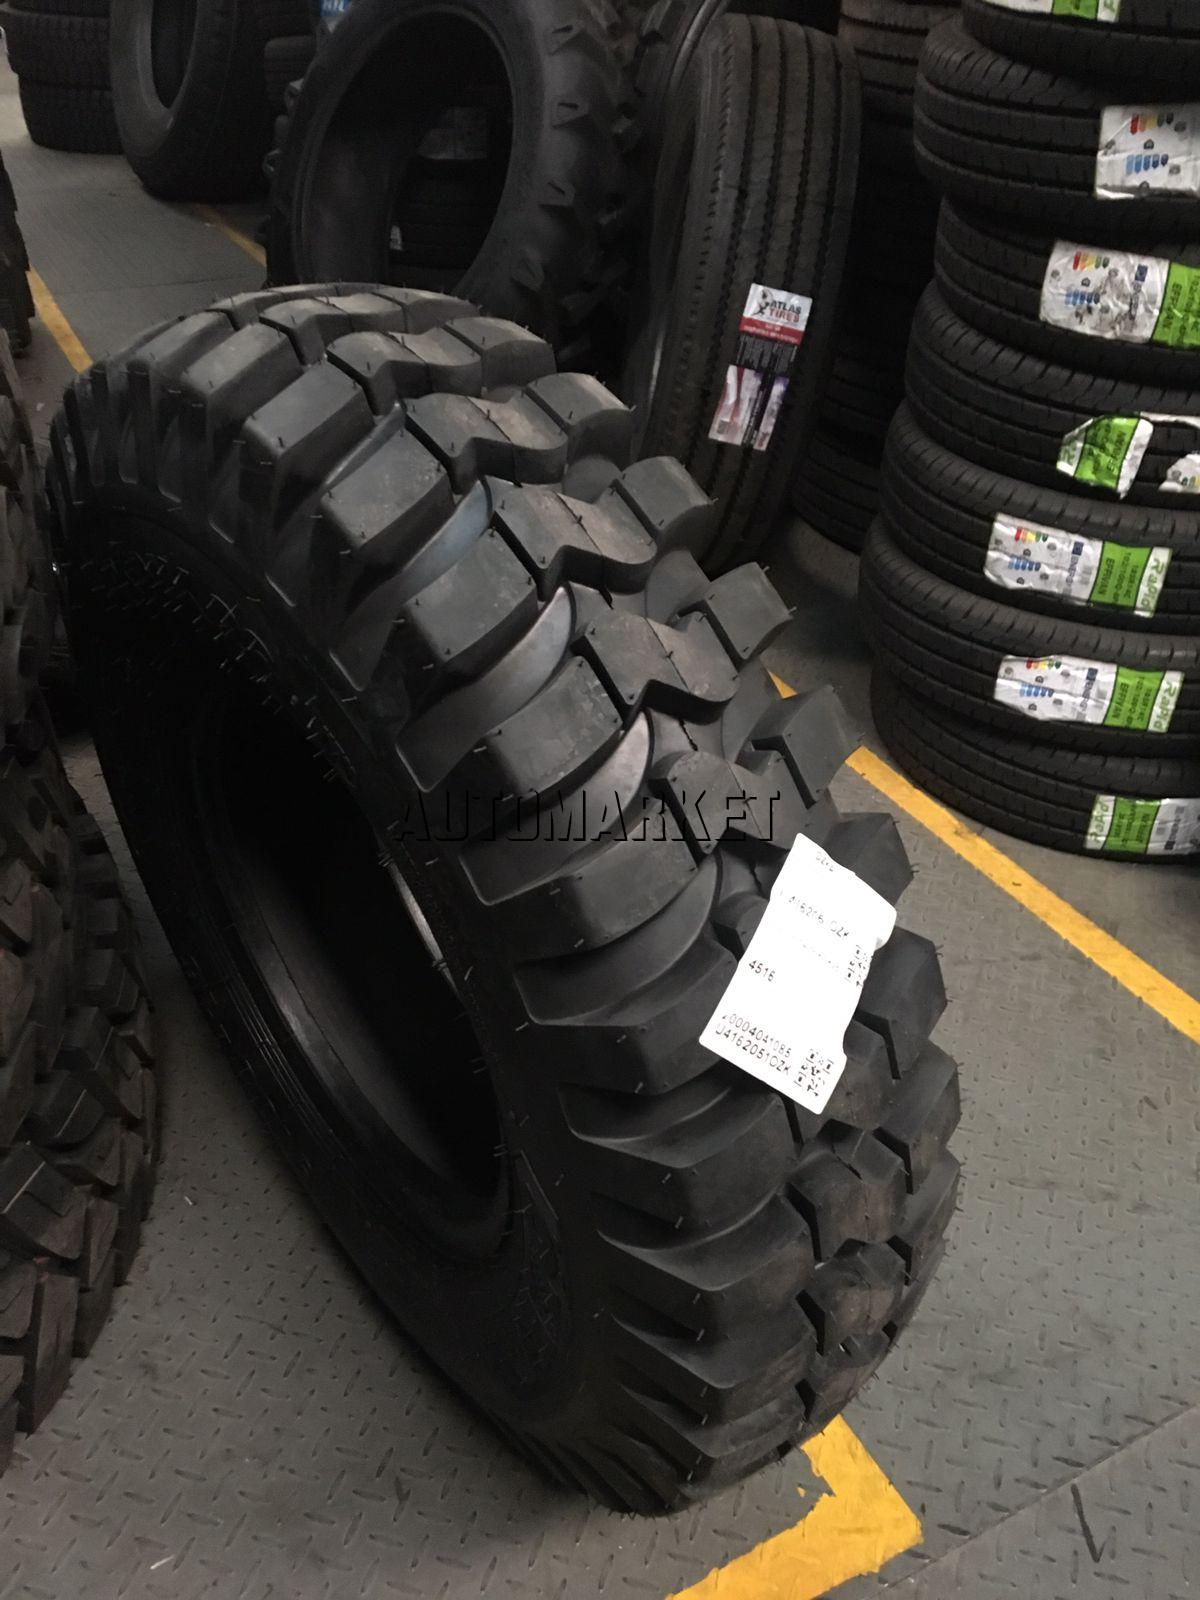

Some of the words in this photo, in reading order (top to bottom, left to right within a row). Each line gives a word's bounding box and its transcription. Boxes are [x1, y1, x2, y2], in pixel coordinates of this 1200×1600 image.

[769, 300, 802, 315] ATLAS
[768, 308, 800, 323] TIRES
[748, 959, 776, 983] 4516
